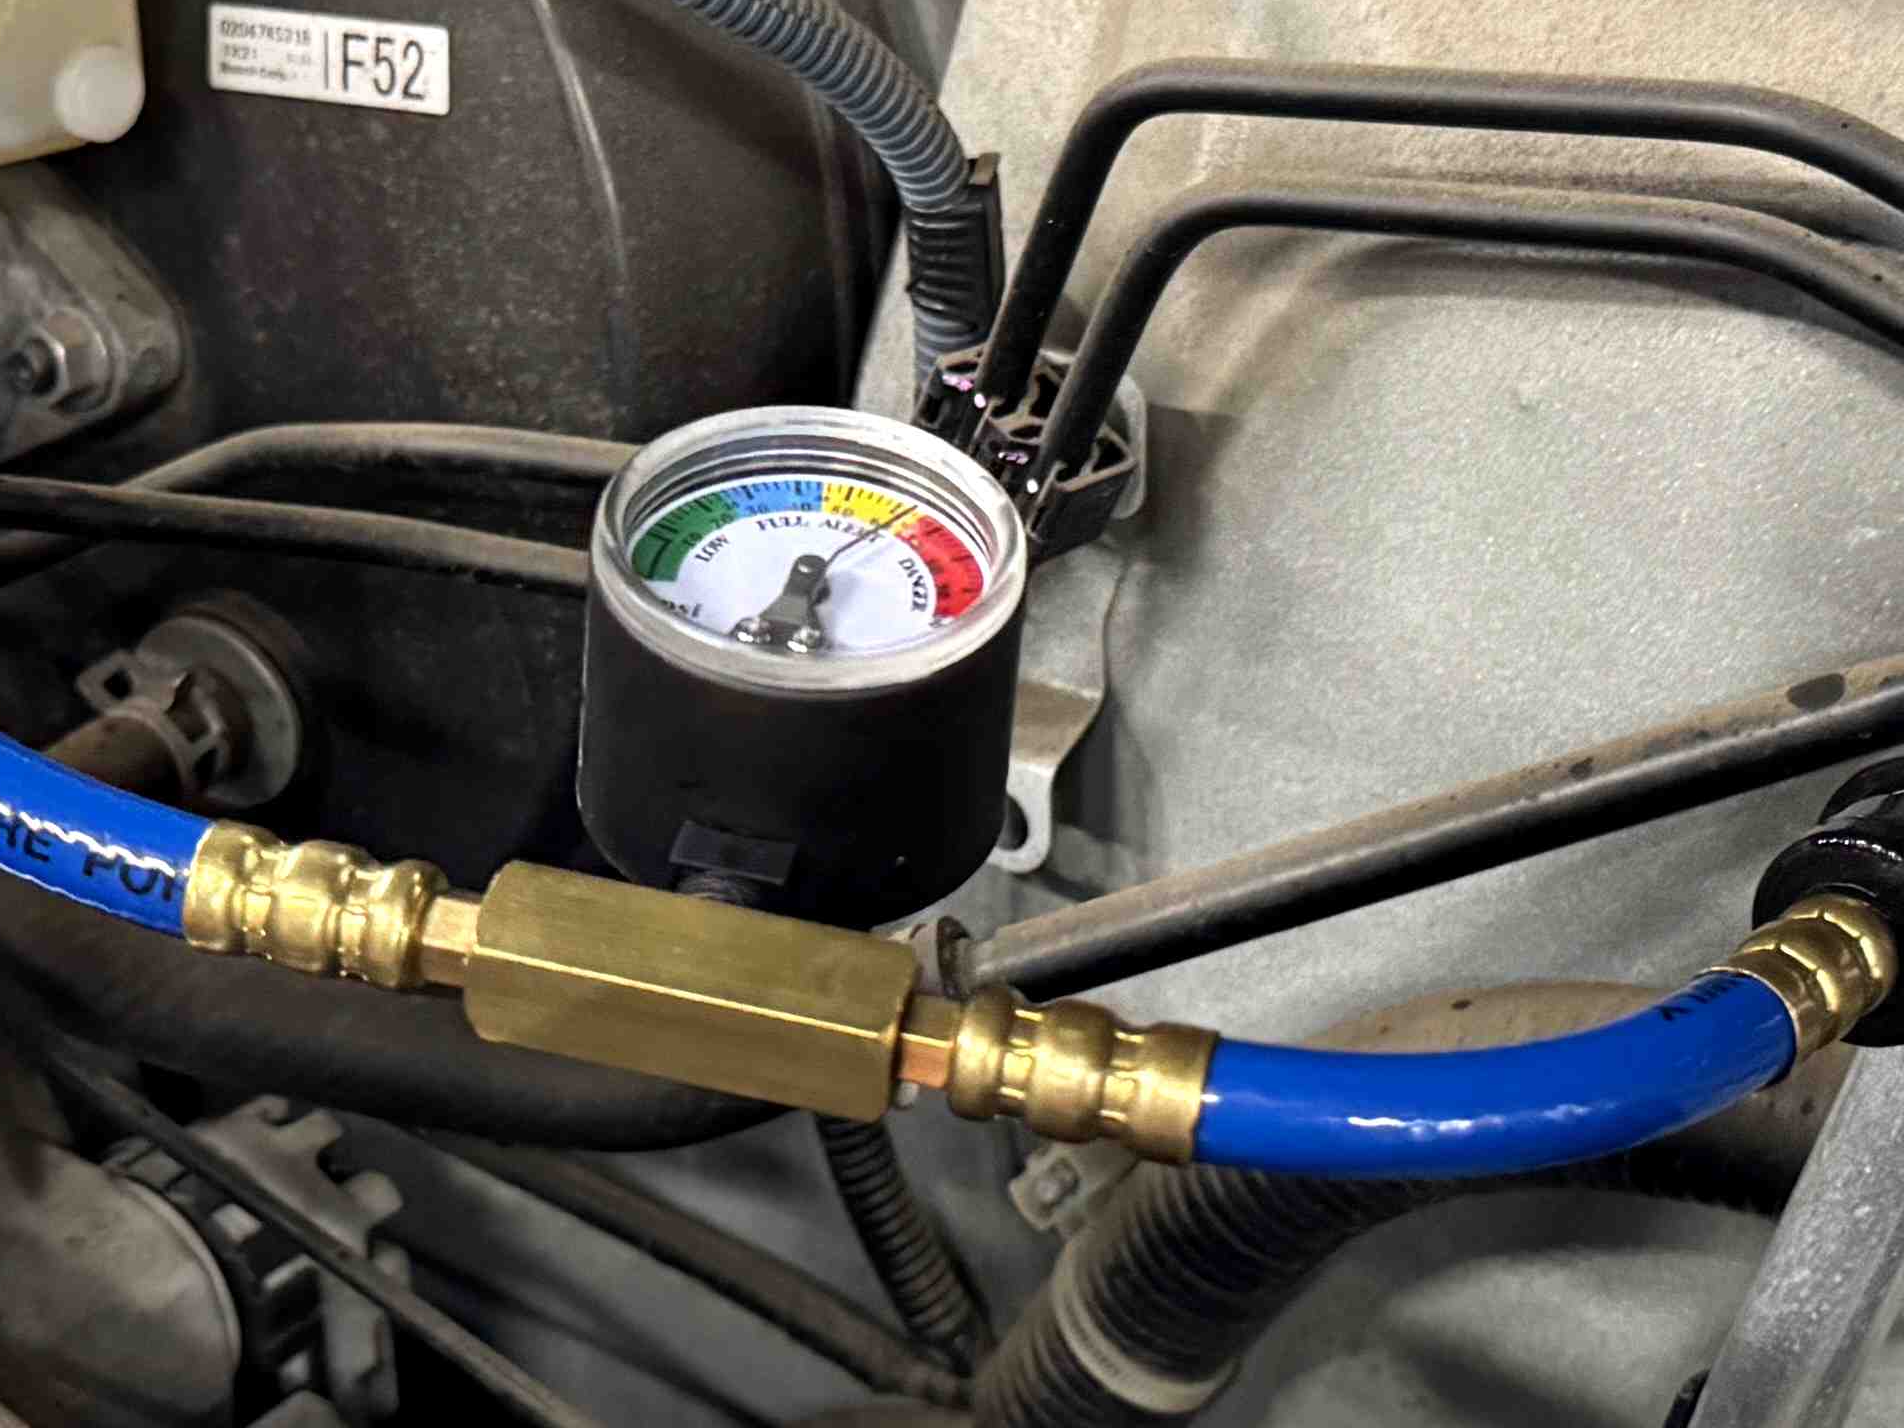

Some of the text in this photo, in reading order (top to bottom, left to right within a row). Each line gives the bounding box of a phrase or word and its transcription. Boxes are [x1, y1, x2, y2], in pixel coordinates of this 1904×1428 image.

[342, 31, 427, 101] F52
[755, 516, 810, 531] FULL
[695, 534, 729, 562] LOW
